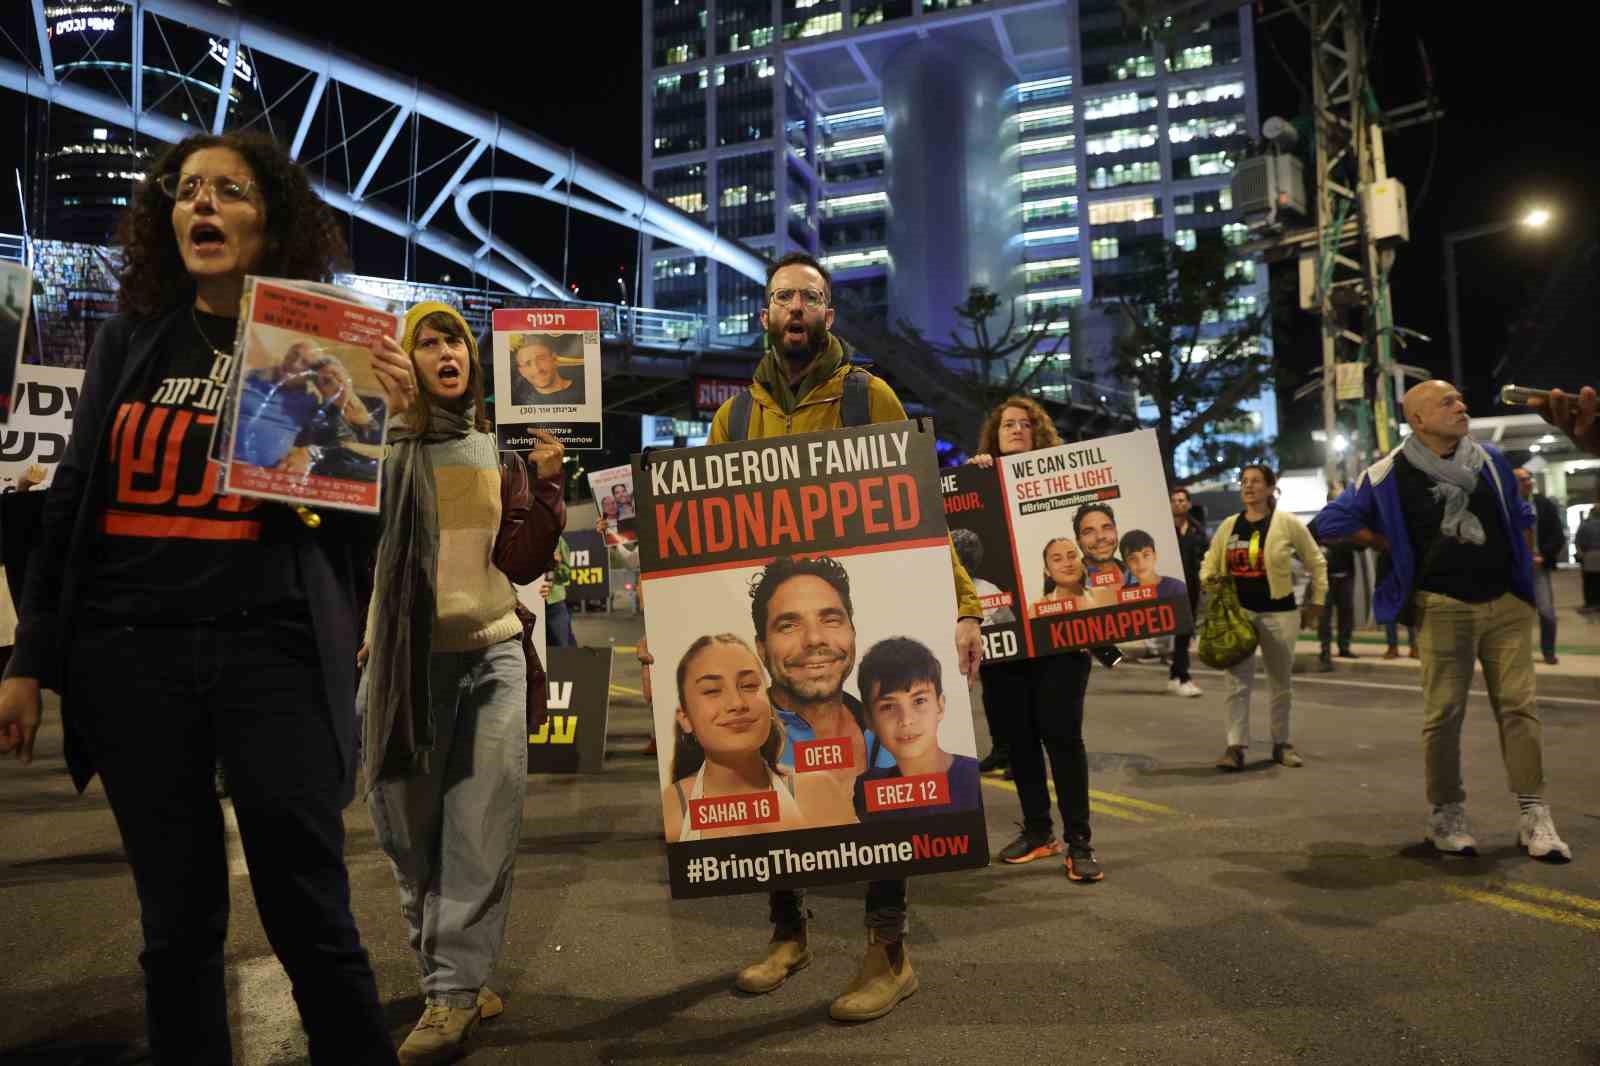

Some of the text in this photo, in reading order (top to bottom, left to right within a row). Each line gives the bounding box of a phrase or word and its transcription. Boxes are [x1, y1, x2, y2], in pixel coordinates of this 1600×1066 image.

[527, 313, 566, 327] חטוף
[651, 431, 910, 497] KALDERON FAMILY
[1012, 447, 1107, 479] WE CAN STILL
[940, 474, 959, 494] HE
[1016, 467, 1118, 500] SEE THE LIGHT.
[655, 473, 921, 560] KIDNAPPED
[943, 491, 985, 514] HOUR.
[1050, 605, 1176, 649] KIDNAPPED
[804, 744, 842, 767] OFER
[876, 781, 938, 806] EREZ 12
[698, 799, 771, 825] SAHAR 16
[686, 834, 969, 884] #BringThemHomeNow
